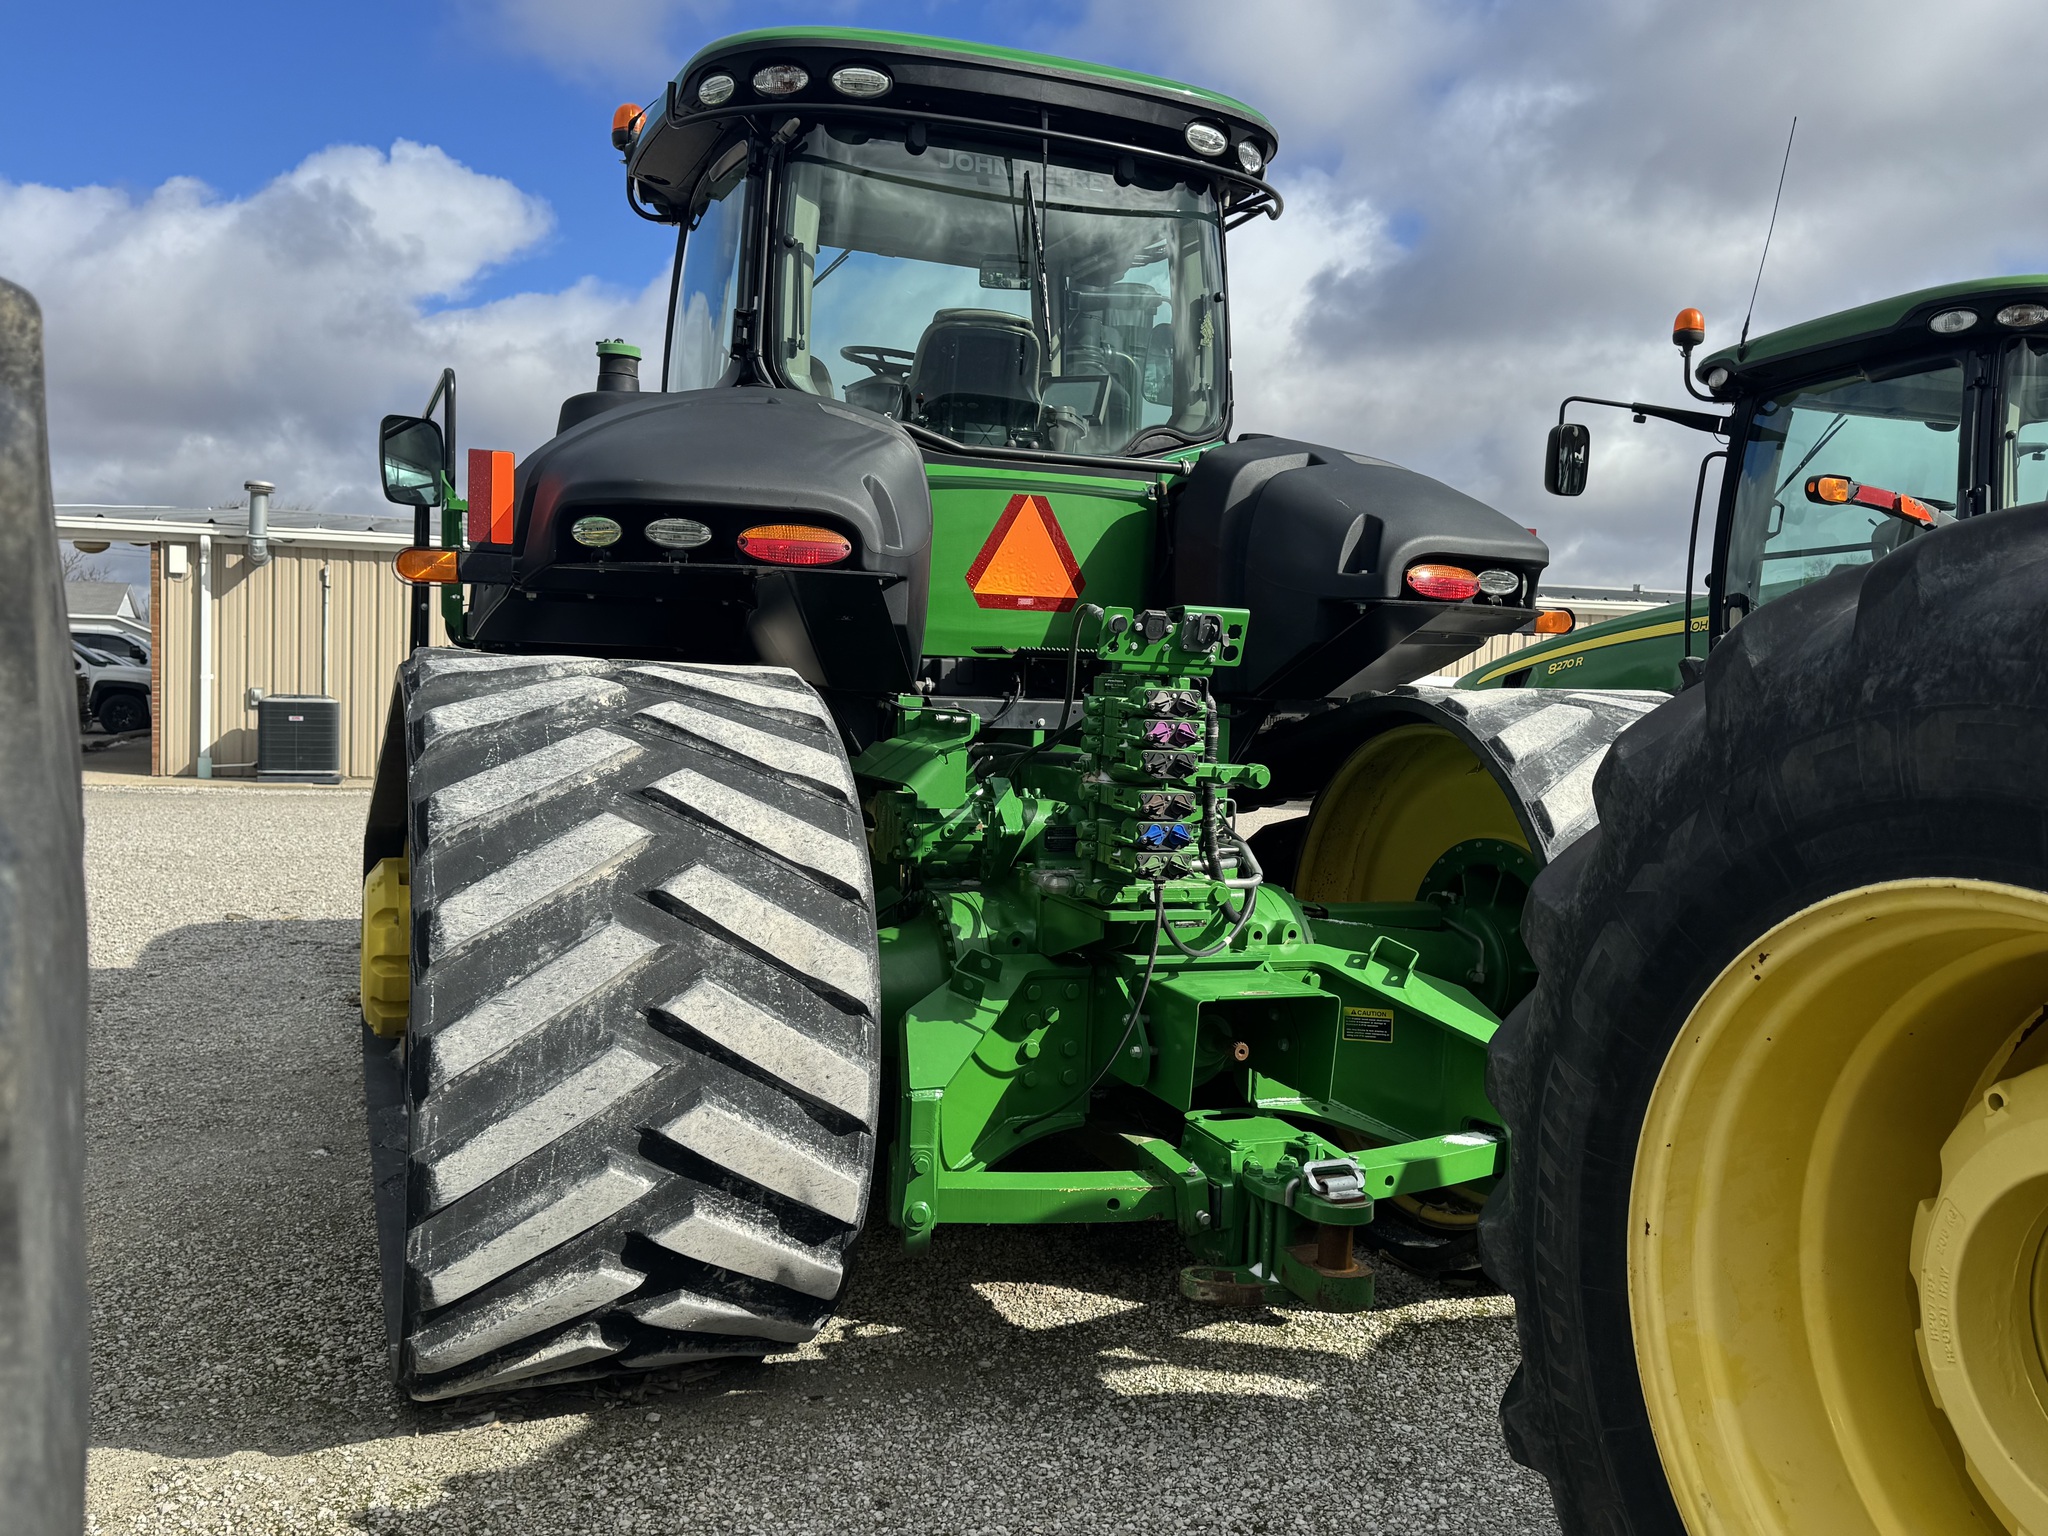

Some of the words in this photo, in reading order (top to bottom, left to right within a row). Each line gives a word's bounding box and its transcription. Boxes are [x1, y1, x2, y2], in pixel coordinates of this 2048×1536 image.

[940, 149, 1012, 177] JOHN
[1547, 658, 1575, 675] 8270
[1357, 1009, 1387, 1017] CAUTION
